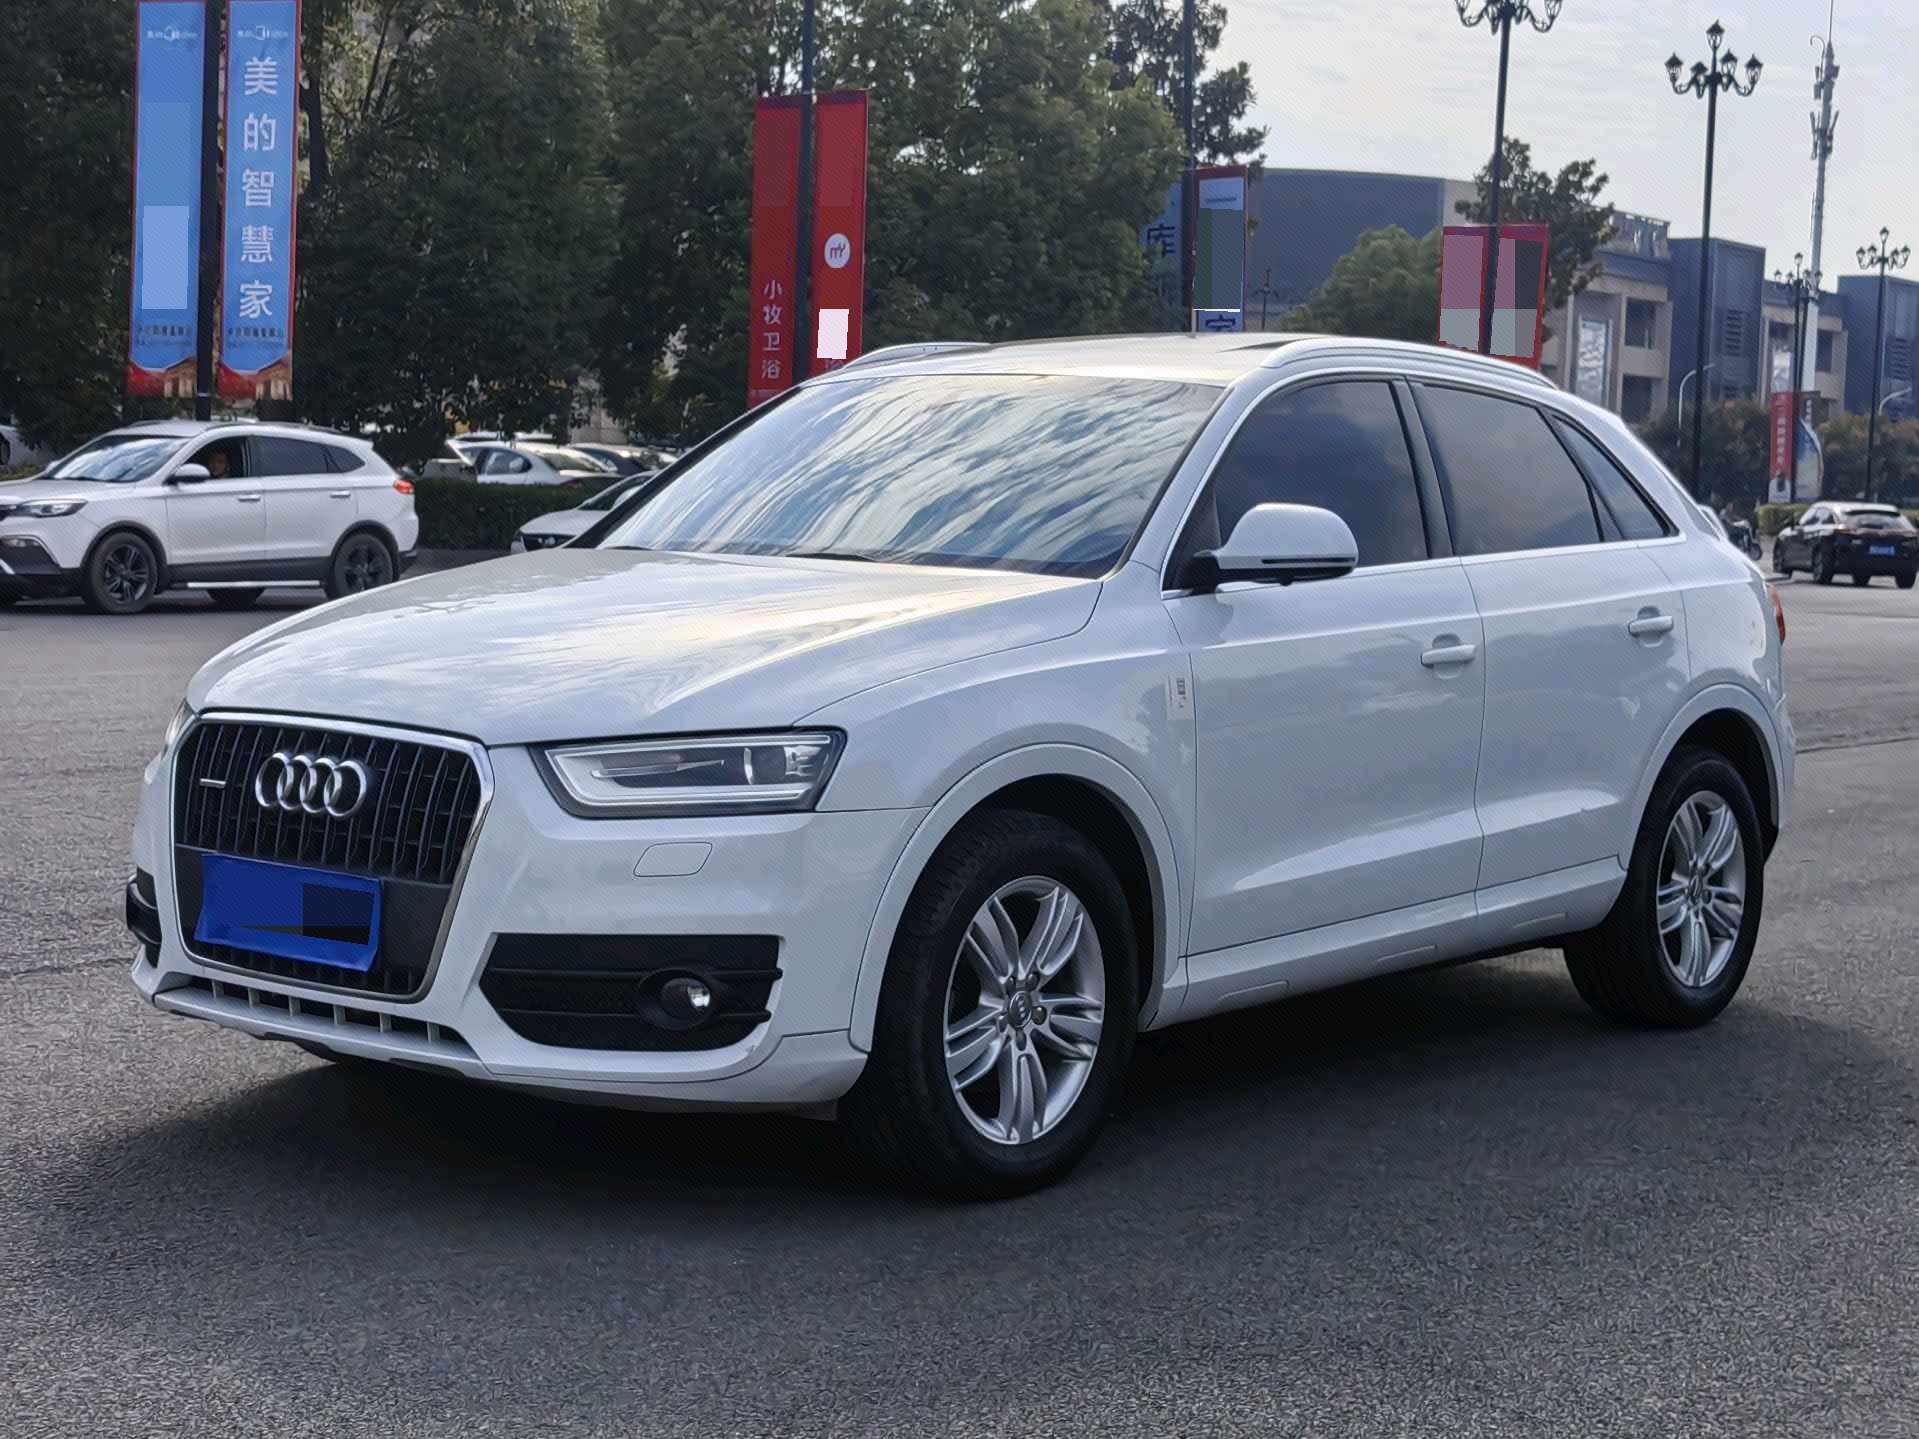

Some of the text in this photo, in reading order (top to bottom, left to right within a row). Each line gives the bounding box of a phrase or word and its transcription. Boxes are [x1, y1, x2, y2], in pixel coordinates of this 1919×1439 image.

[239, 56, 278, 318] 美的智慧家
